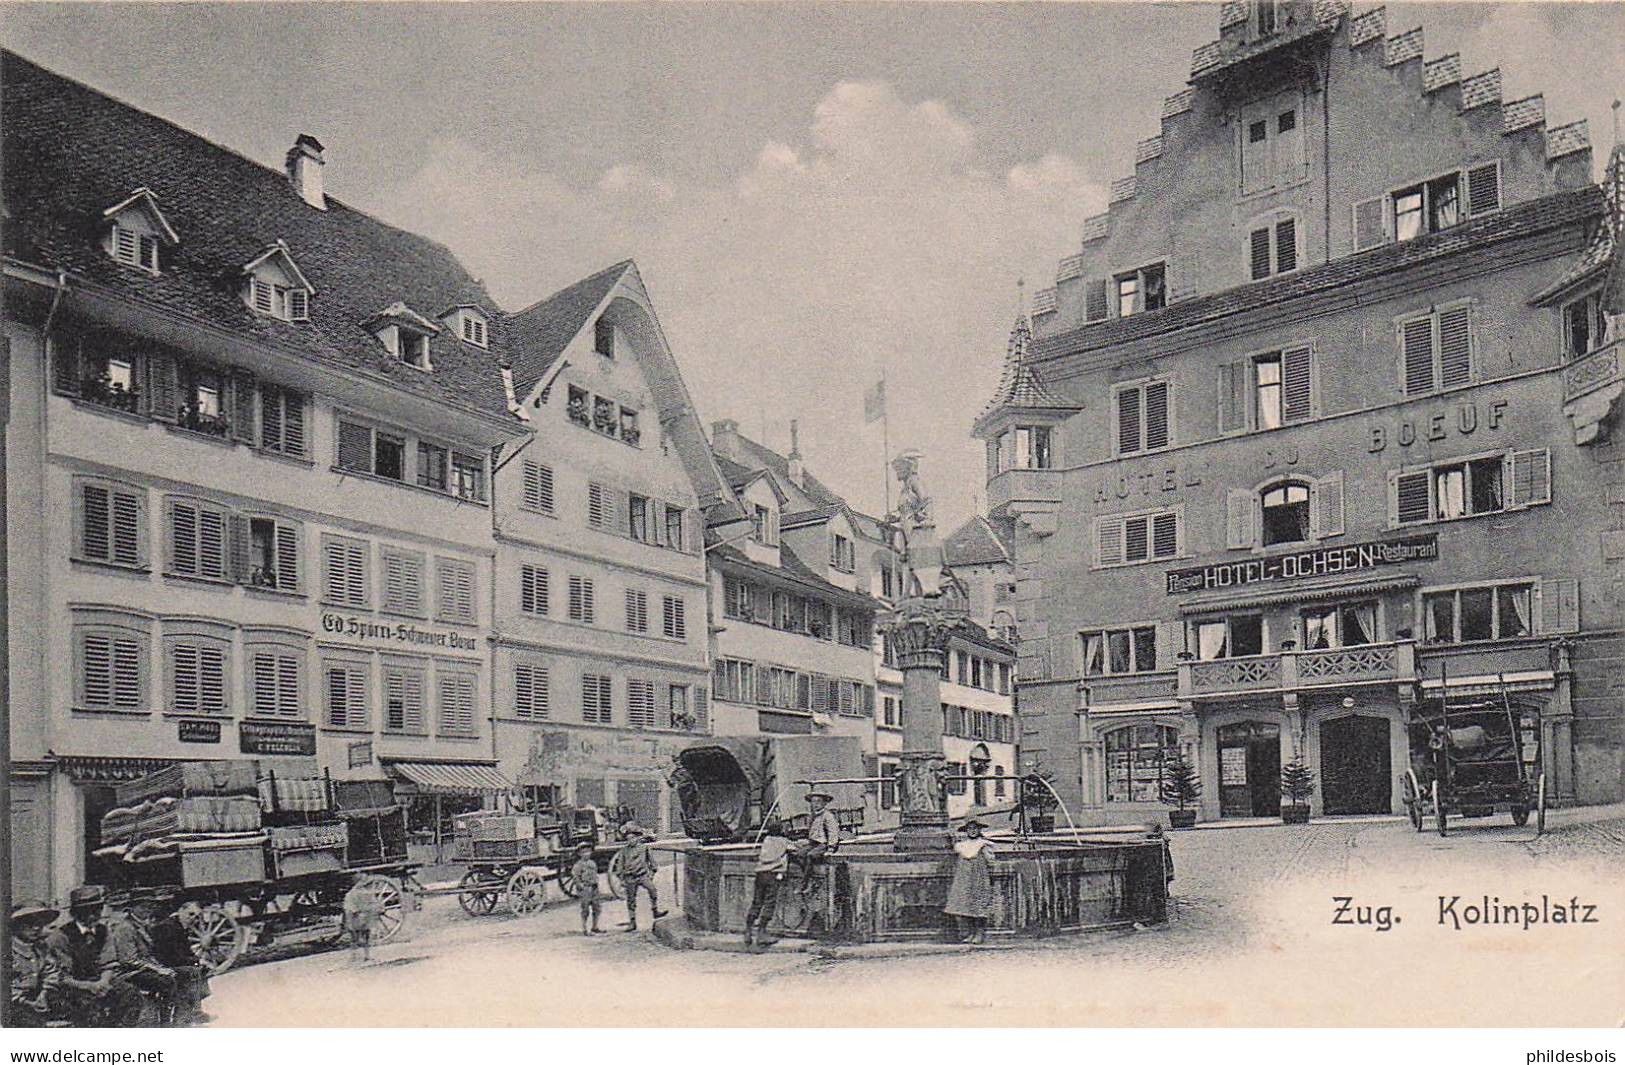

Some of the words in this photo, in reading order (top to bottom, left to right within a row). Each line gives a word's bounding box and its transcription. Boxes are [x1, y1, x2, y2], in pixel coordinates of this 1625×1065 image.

[1367, 399, 1508, 453] BOEUF
[1203, 544, 1375, 589] HOTEL-OCHSEN
[1374, 541, 1437, 562] Restaurant
